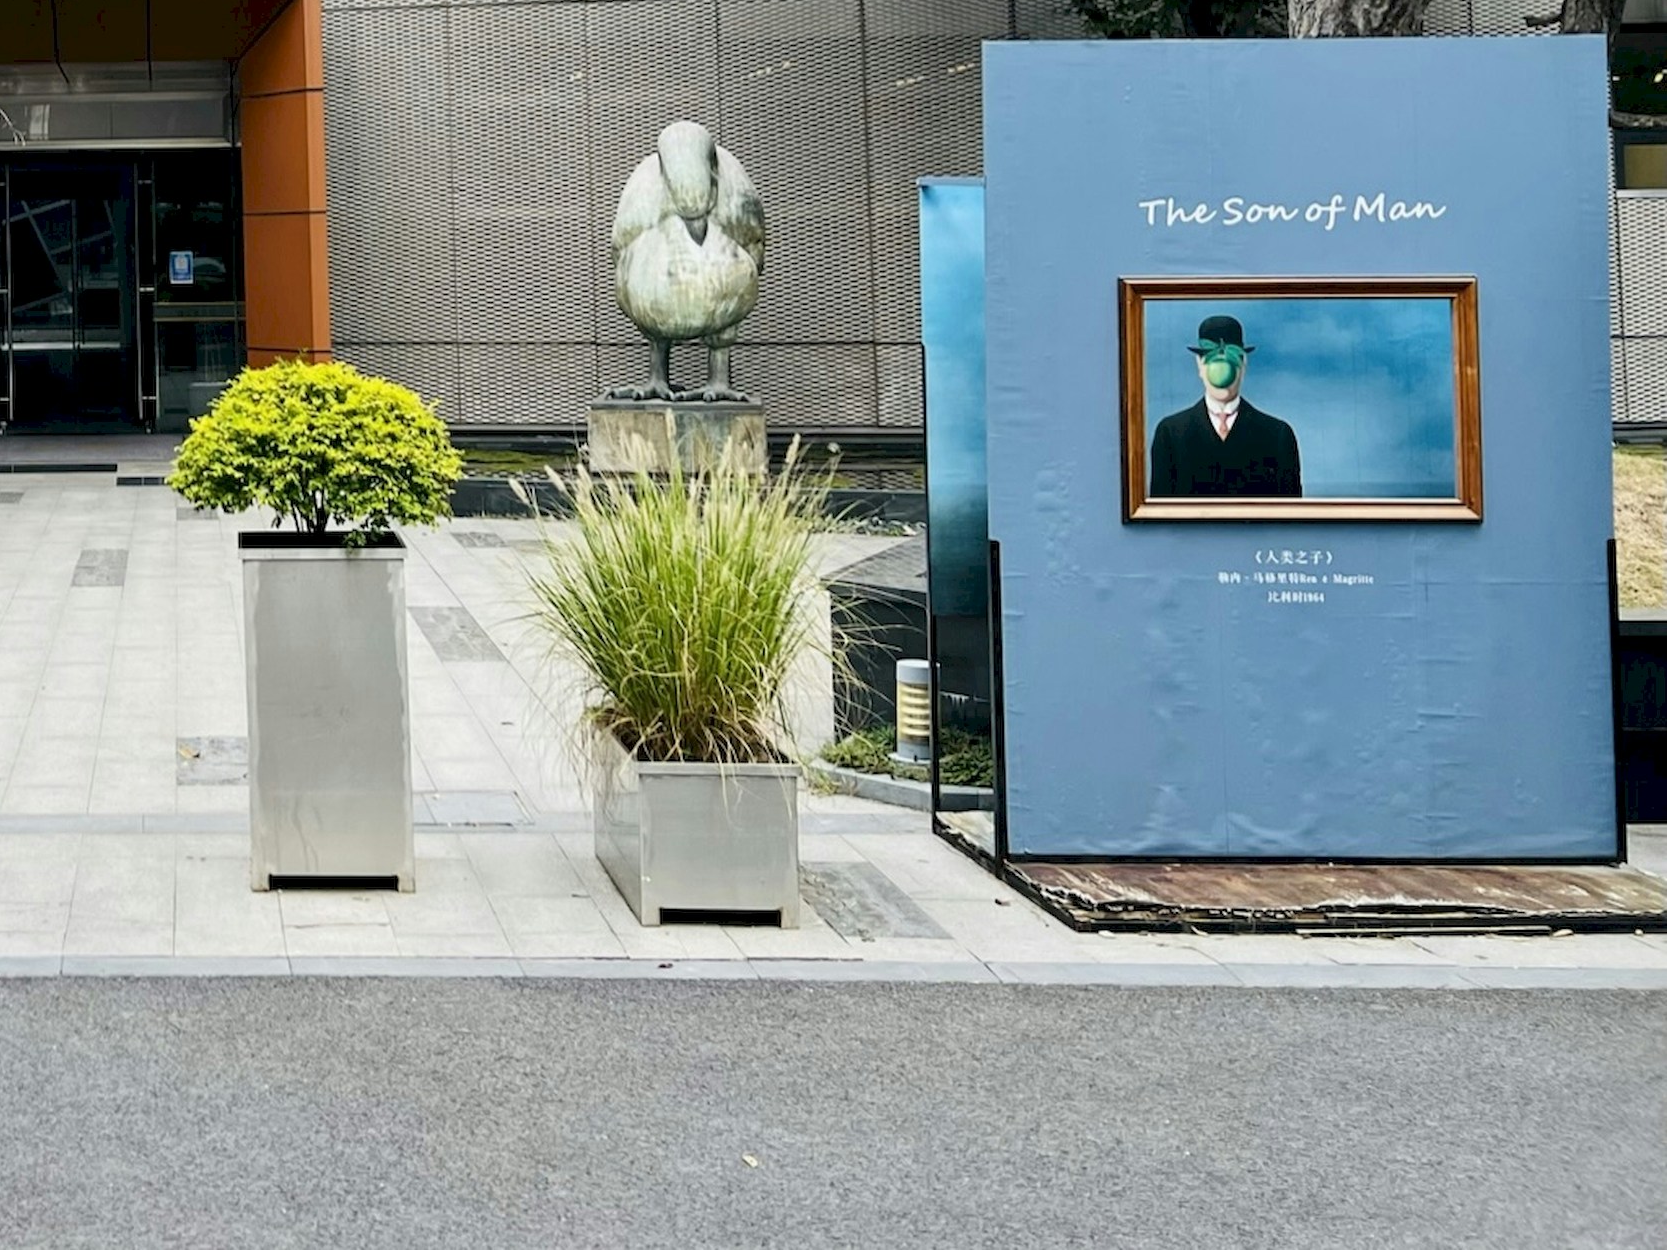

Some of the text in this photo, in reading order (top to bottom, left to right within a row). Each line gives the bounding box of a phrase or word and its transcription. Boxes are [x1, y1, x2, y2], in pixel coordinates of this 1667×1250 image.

[1138, 192, 1447, 231] The Son of Man
[1255, 550, 1333, 565] 《人类之子》
[1333, 574, 1374, 585] Magritte
